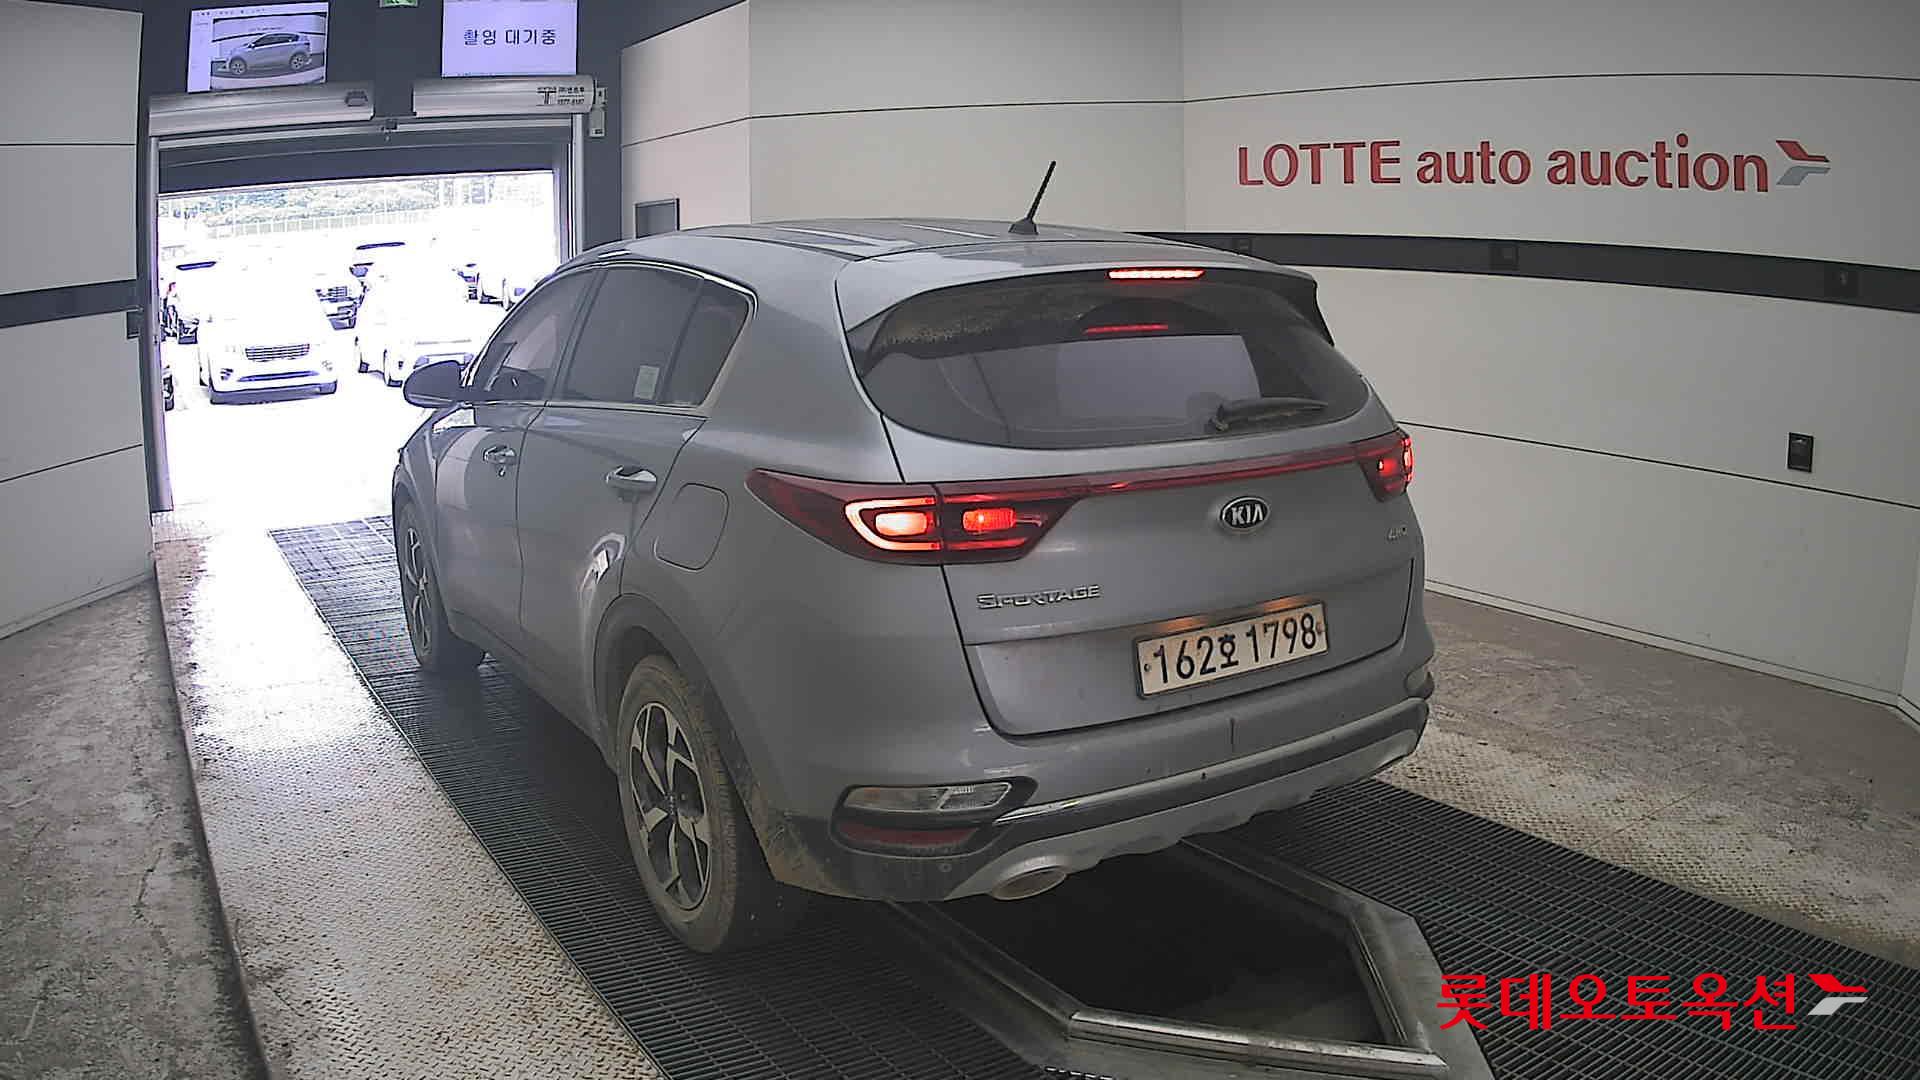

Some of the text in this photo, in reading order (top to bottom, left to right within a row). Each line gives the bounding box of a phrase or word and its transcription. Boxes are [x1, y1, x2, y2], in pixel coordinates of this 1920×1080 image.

[505, 29, 555, 45] 대기중
[1238, 133, 1769, 193] LOTTE auto auction
[1231, 503, 1264, 526] KIA
[977, 584, 1101, 609] SPORTAGE
[1153, 613, 1316, 684] 162호 1798
